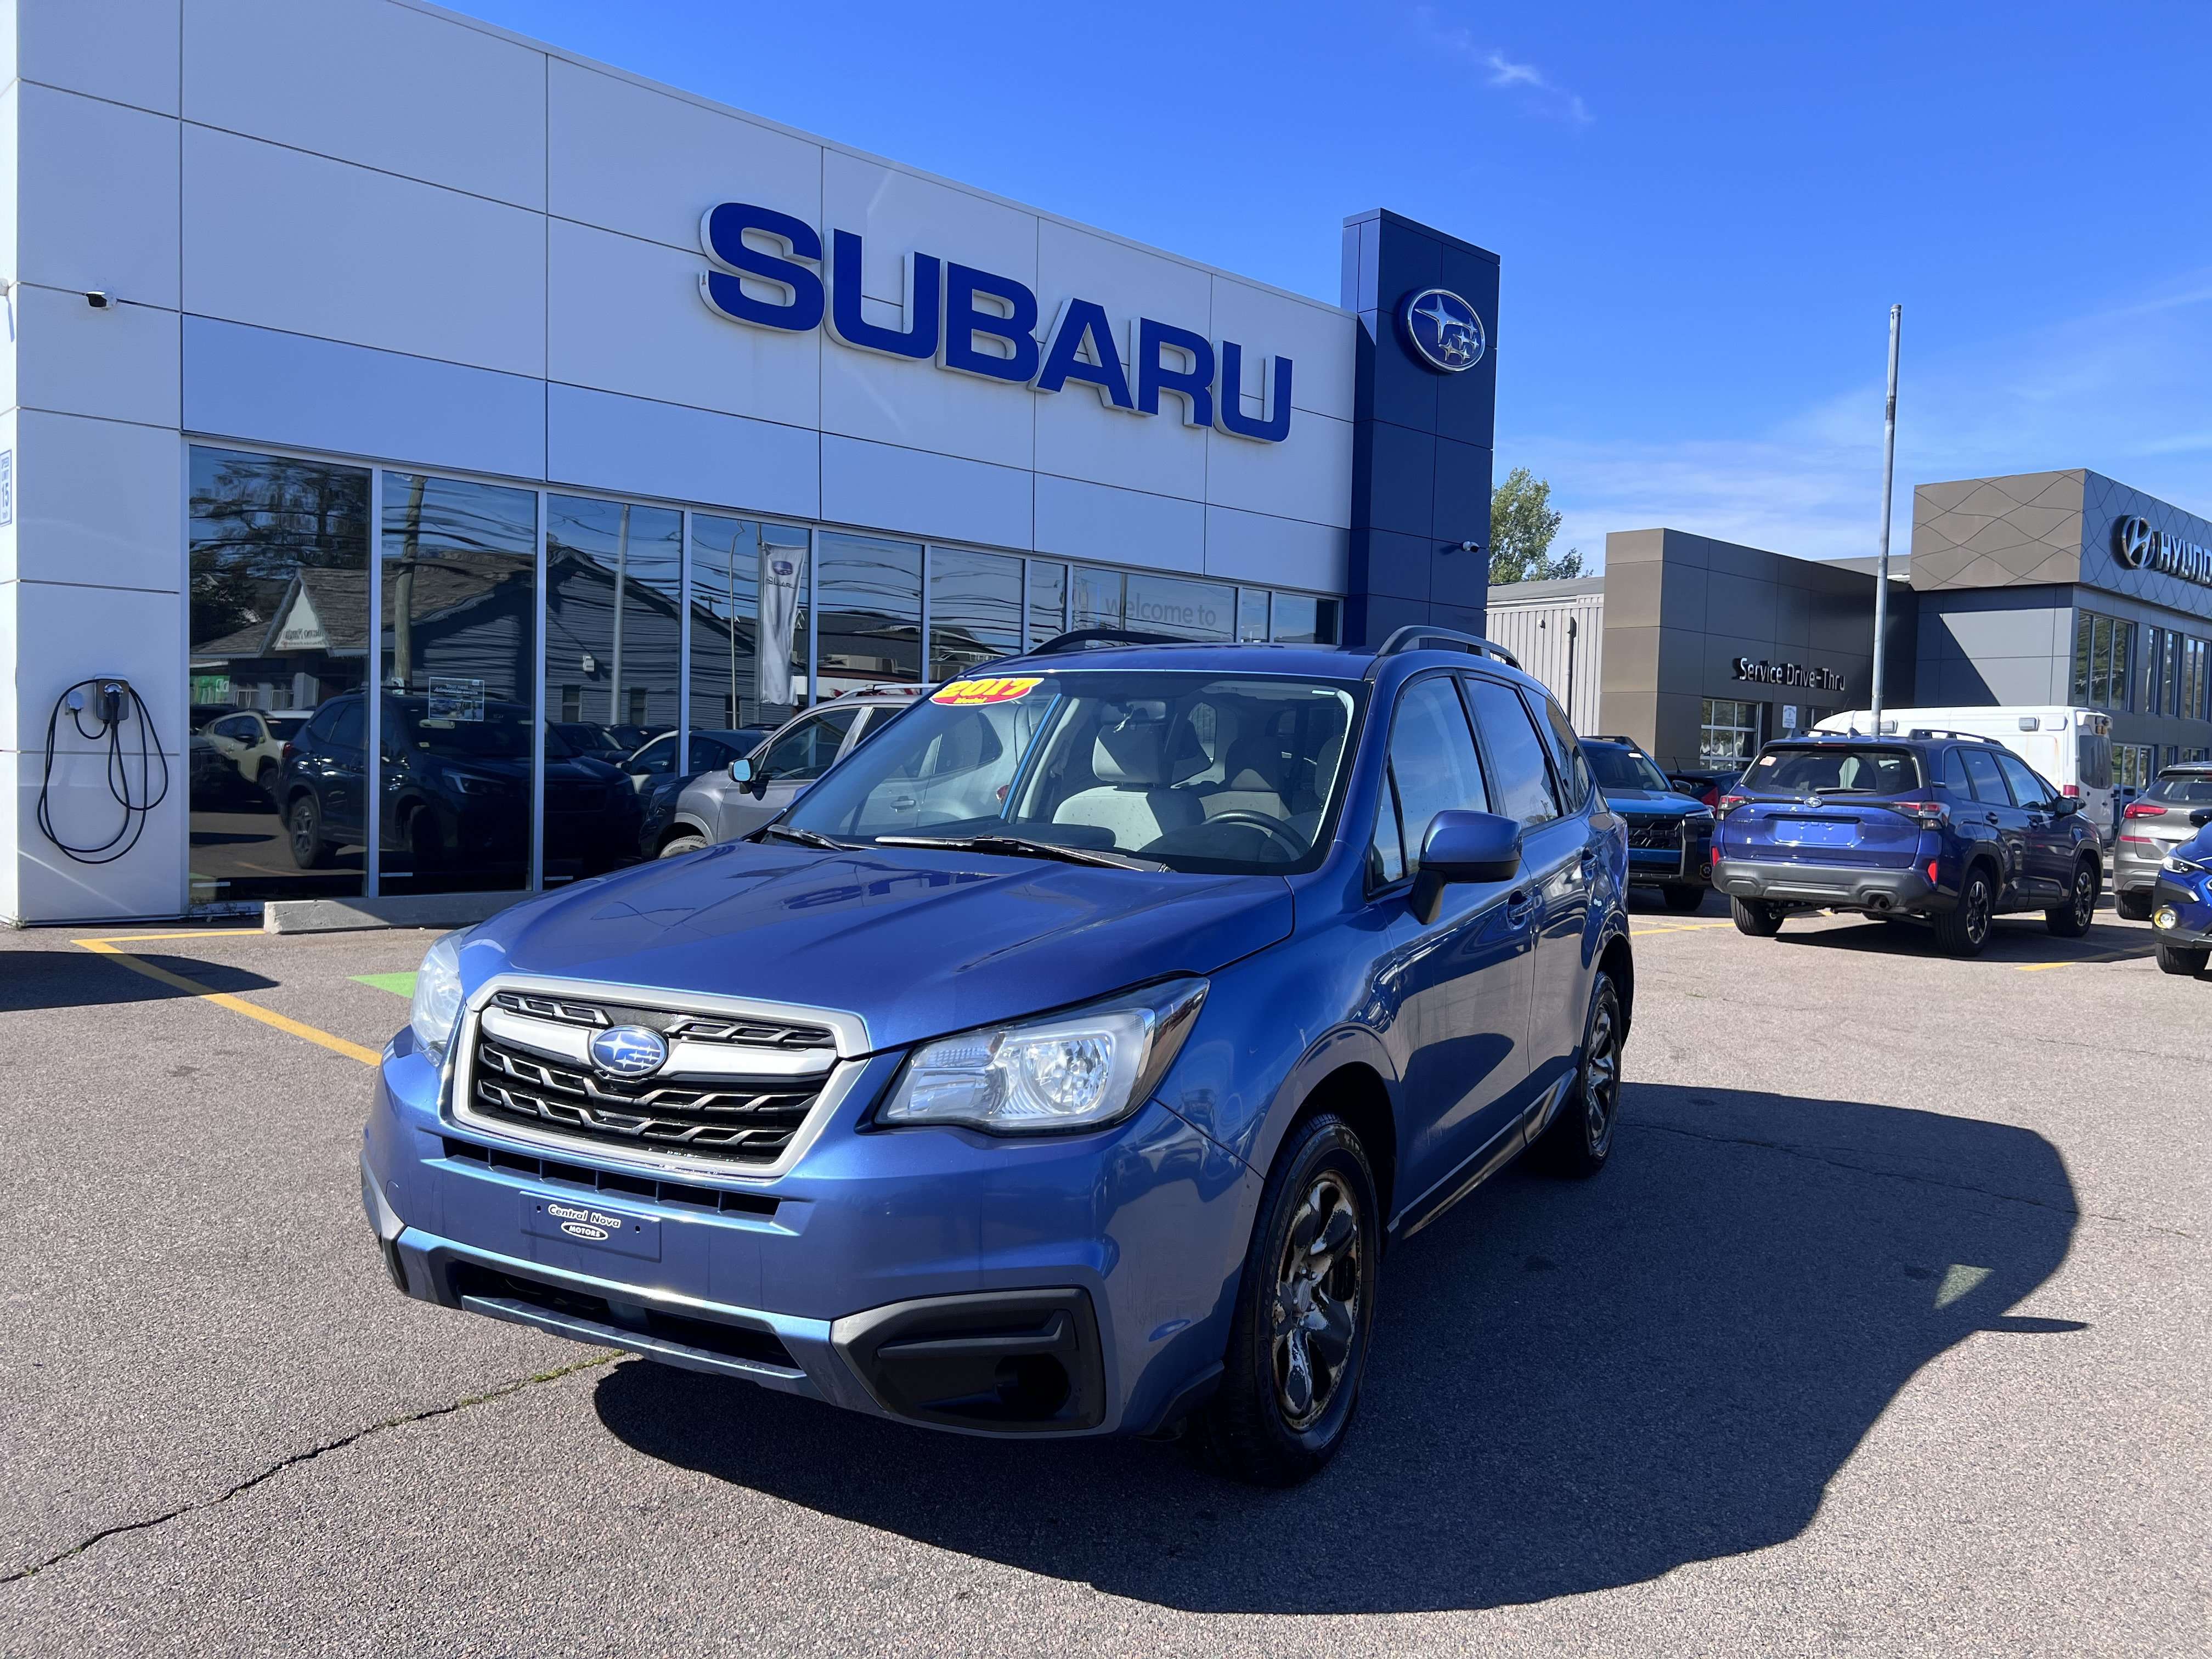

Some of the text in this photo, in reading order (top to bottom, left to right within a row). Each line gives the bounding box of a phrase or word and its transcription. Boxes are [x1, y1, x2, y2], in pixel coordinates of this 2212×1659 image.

[701, 201, 1293, 443] SUBARU
[2, 482, 9, 507] 15
[1105, 592, 1216, 627] welcome to
[1739, 657, 1845, 691] Service Drive-Thru
[932, 678, 1042, 698] 2017
[549, 1204, 621, 1228] Central Nova
[568, 1225, 601, 1238] MOTORS
